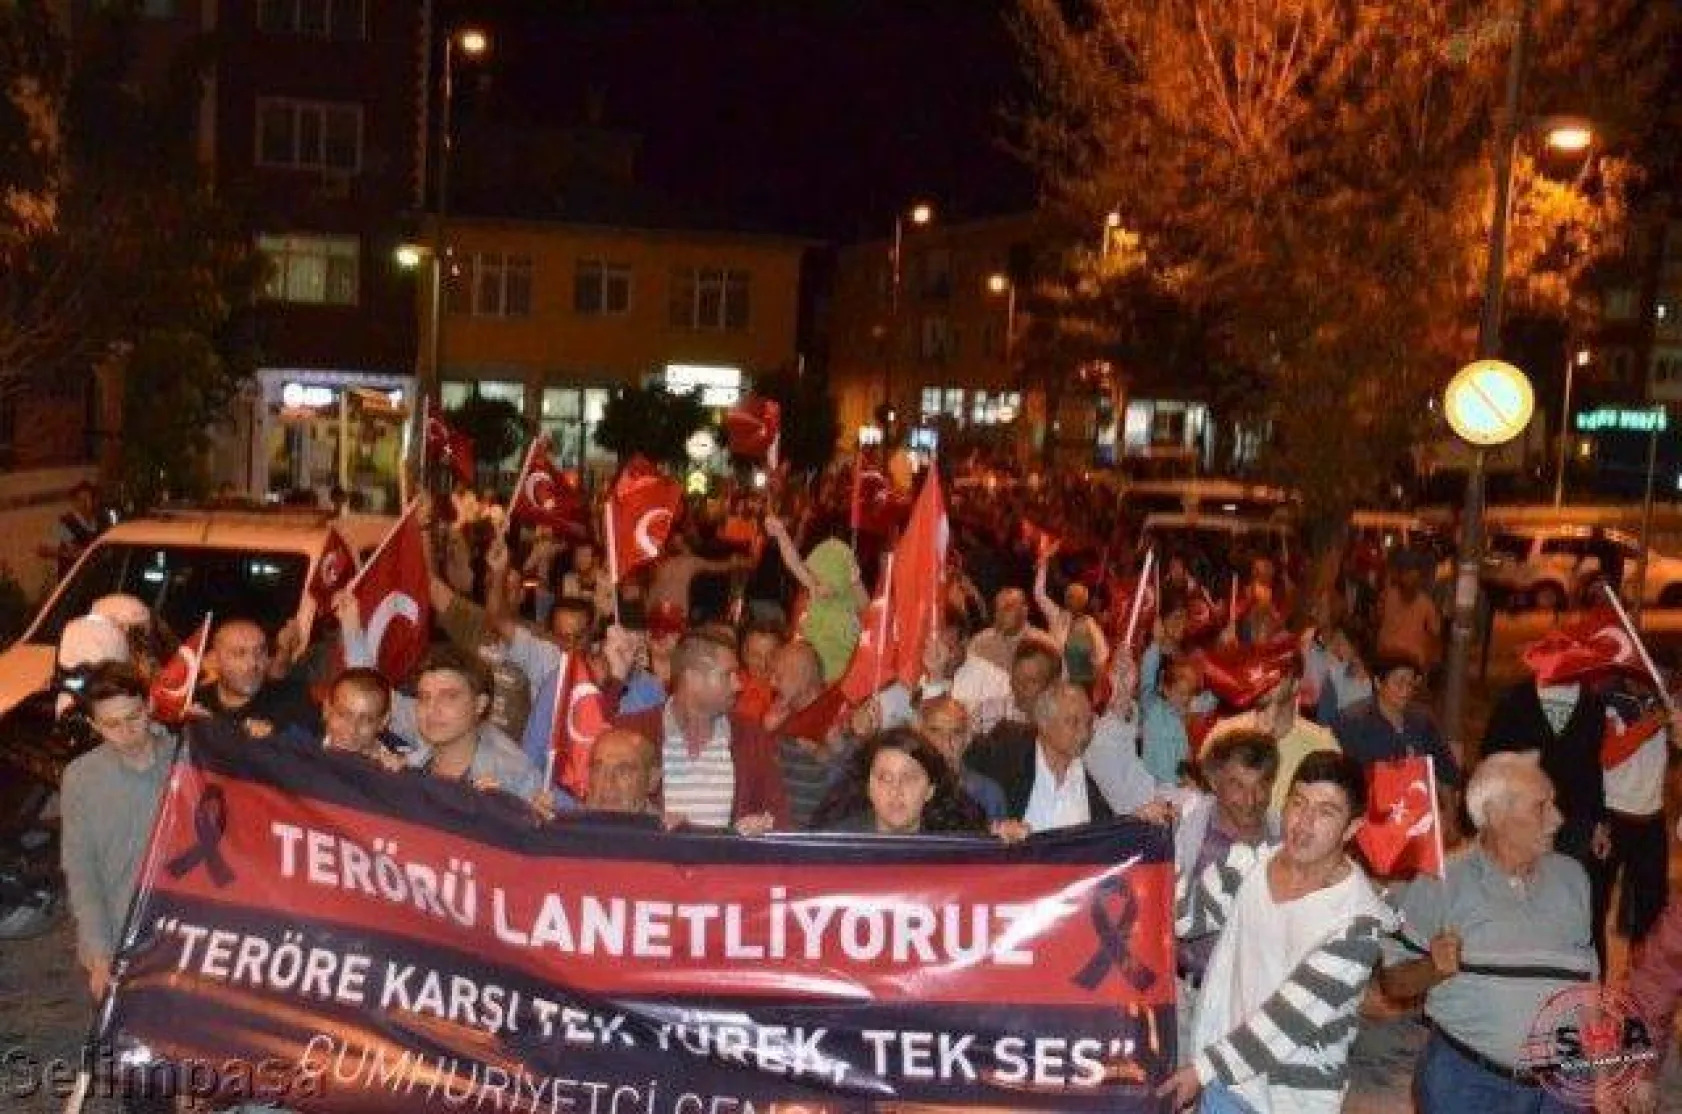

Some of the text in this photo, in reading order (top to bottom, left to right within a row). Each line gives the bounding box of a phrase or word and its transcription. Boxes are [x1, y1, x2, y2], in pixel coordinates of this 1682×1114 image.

[271, 822, 1034, 966] TERÖRÜ LANETLİYORUZ
[861, 1030, 978, 1081] TEK
